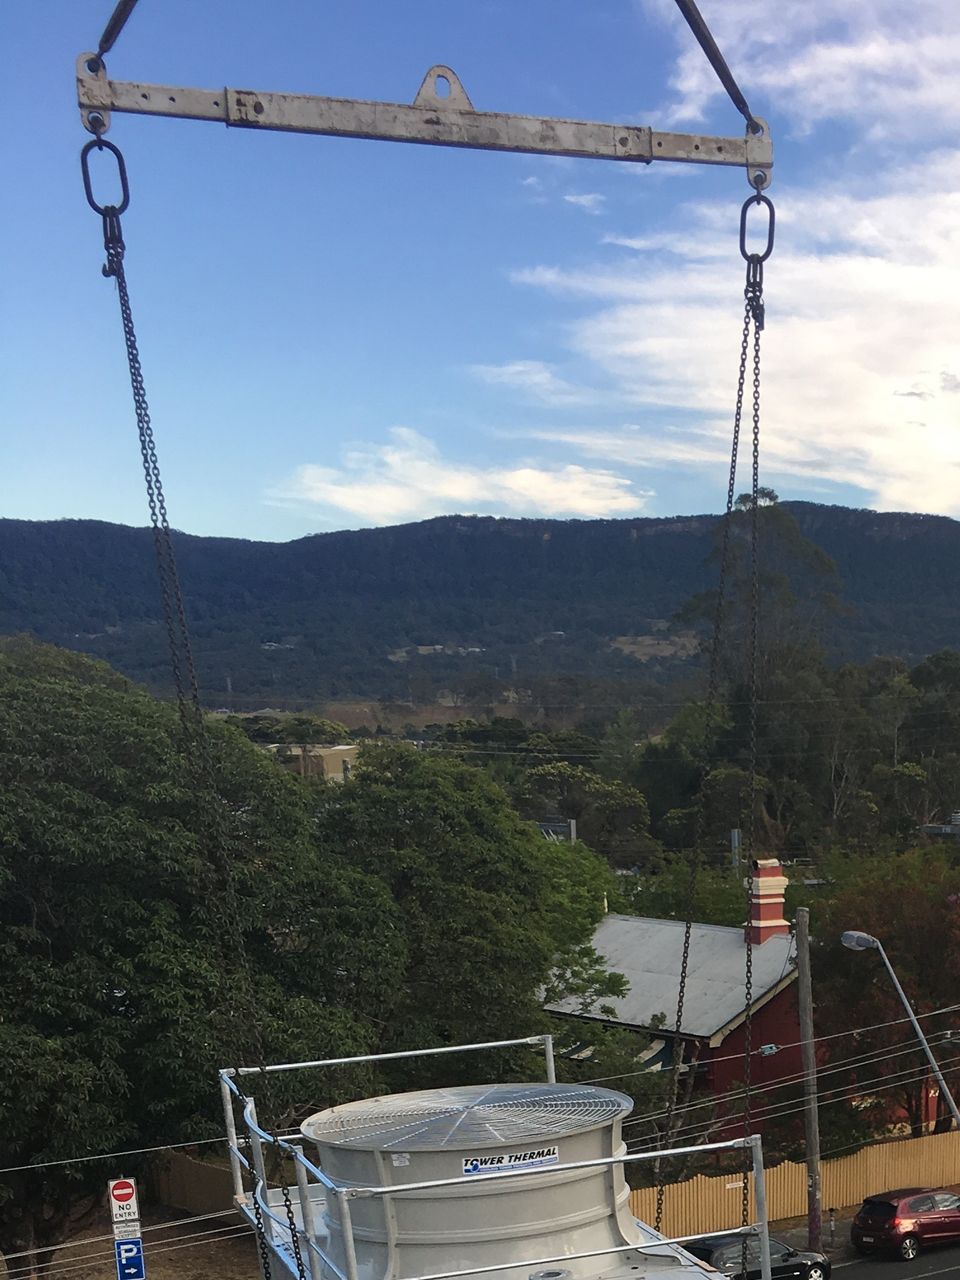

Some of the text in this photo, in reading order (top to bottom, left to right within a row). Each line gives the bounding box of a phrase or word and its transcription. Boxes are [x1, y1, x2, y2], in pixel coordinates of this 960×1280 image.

[463, 1156, 504, 1167] TOWER
[507, 1147, 557, 1163] THERMAL
[114, 1211, 137, 1219] ENTRY
[120, 1244, 138, 1264] P
